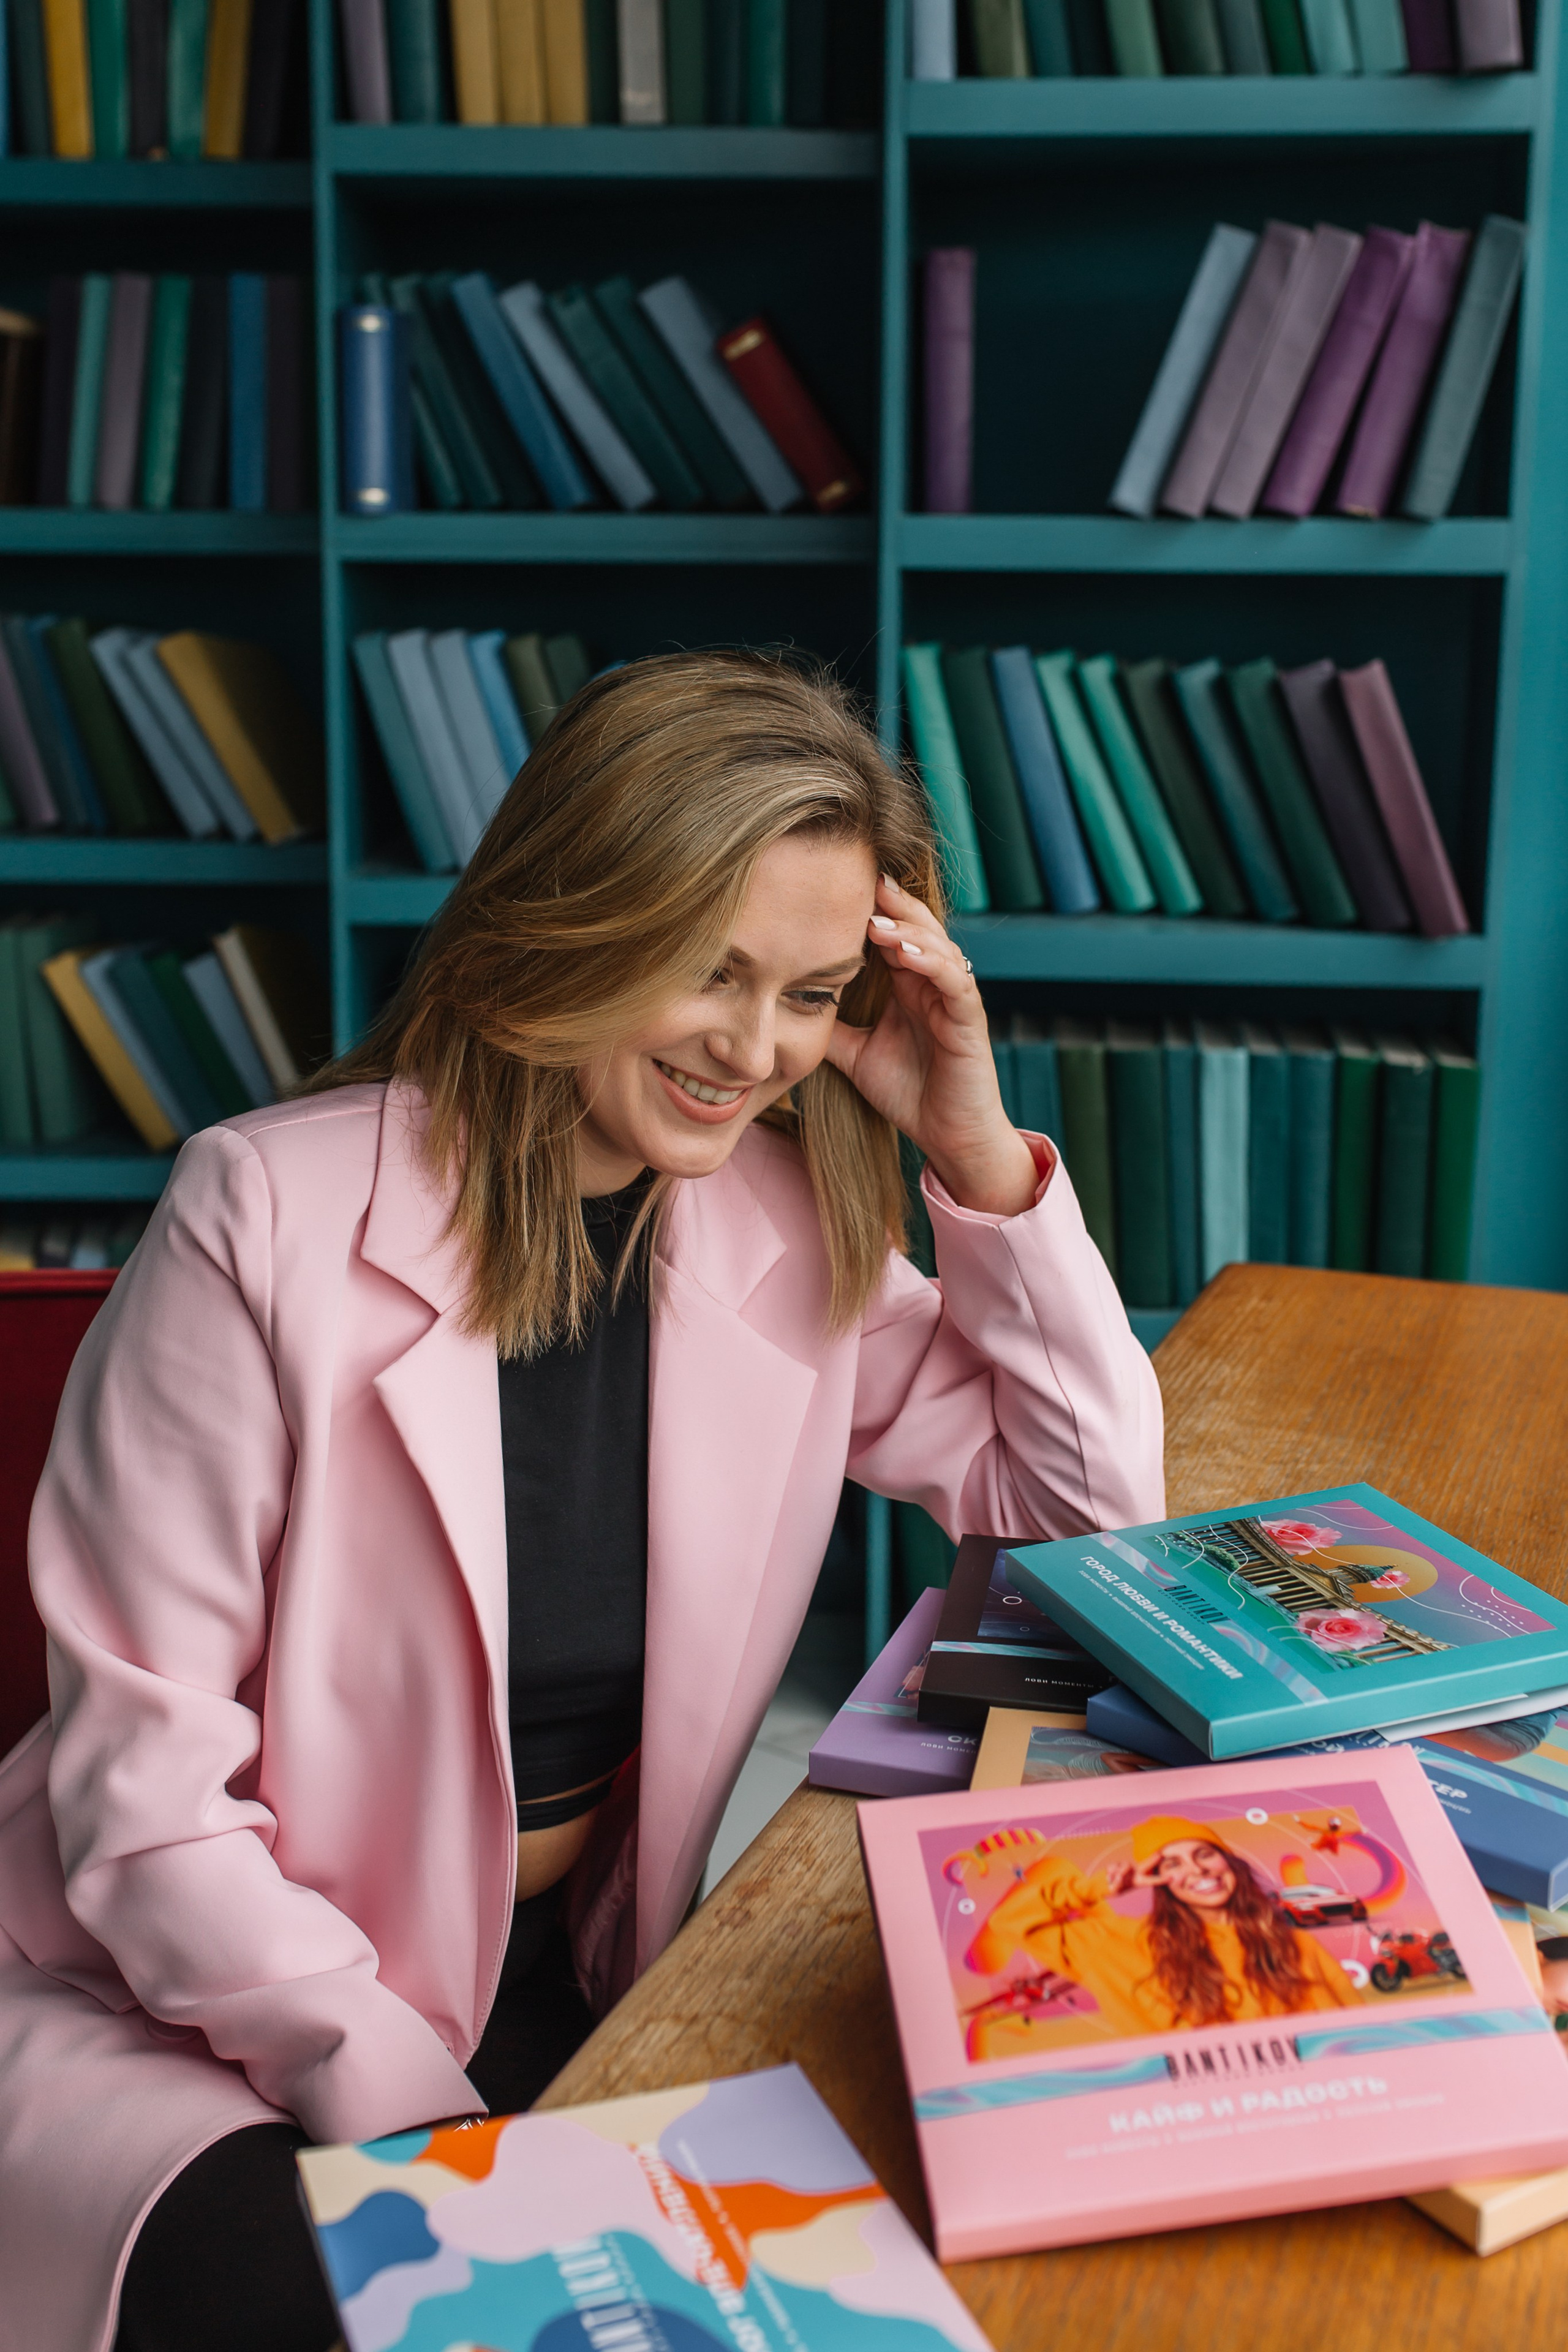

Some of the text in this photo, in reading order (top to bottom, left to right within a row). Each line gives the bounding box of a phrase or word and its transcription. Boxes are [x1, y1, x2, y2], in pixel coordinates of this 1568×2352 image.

[1080, 1556, 1116, 1582] ГОРОД
[1113, 1581, 1159, 1612] ЛЮБВИ
[1152, 1611, 1170, 1620] И
[1163, 1619, 1243, 1679] РОМАНТИКИ
[1164, 1585, 1231, 1623] BANTIKOV
[948, 1735, 977, 1745] СК
[1164, 2035, 1305, 2081] BANTIKOV
[1108, 2100, 1205, 2133] КАЙФ
[1210, 2096, 1236, 2117] И
[1240, 2076, 1389, 2114] РАДОСТЬ
